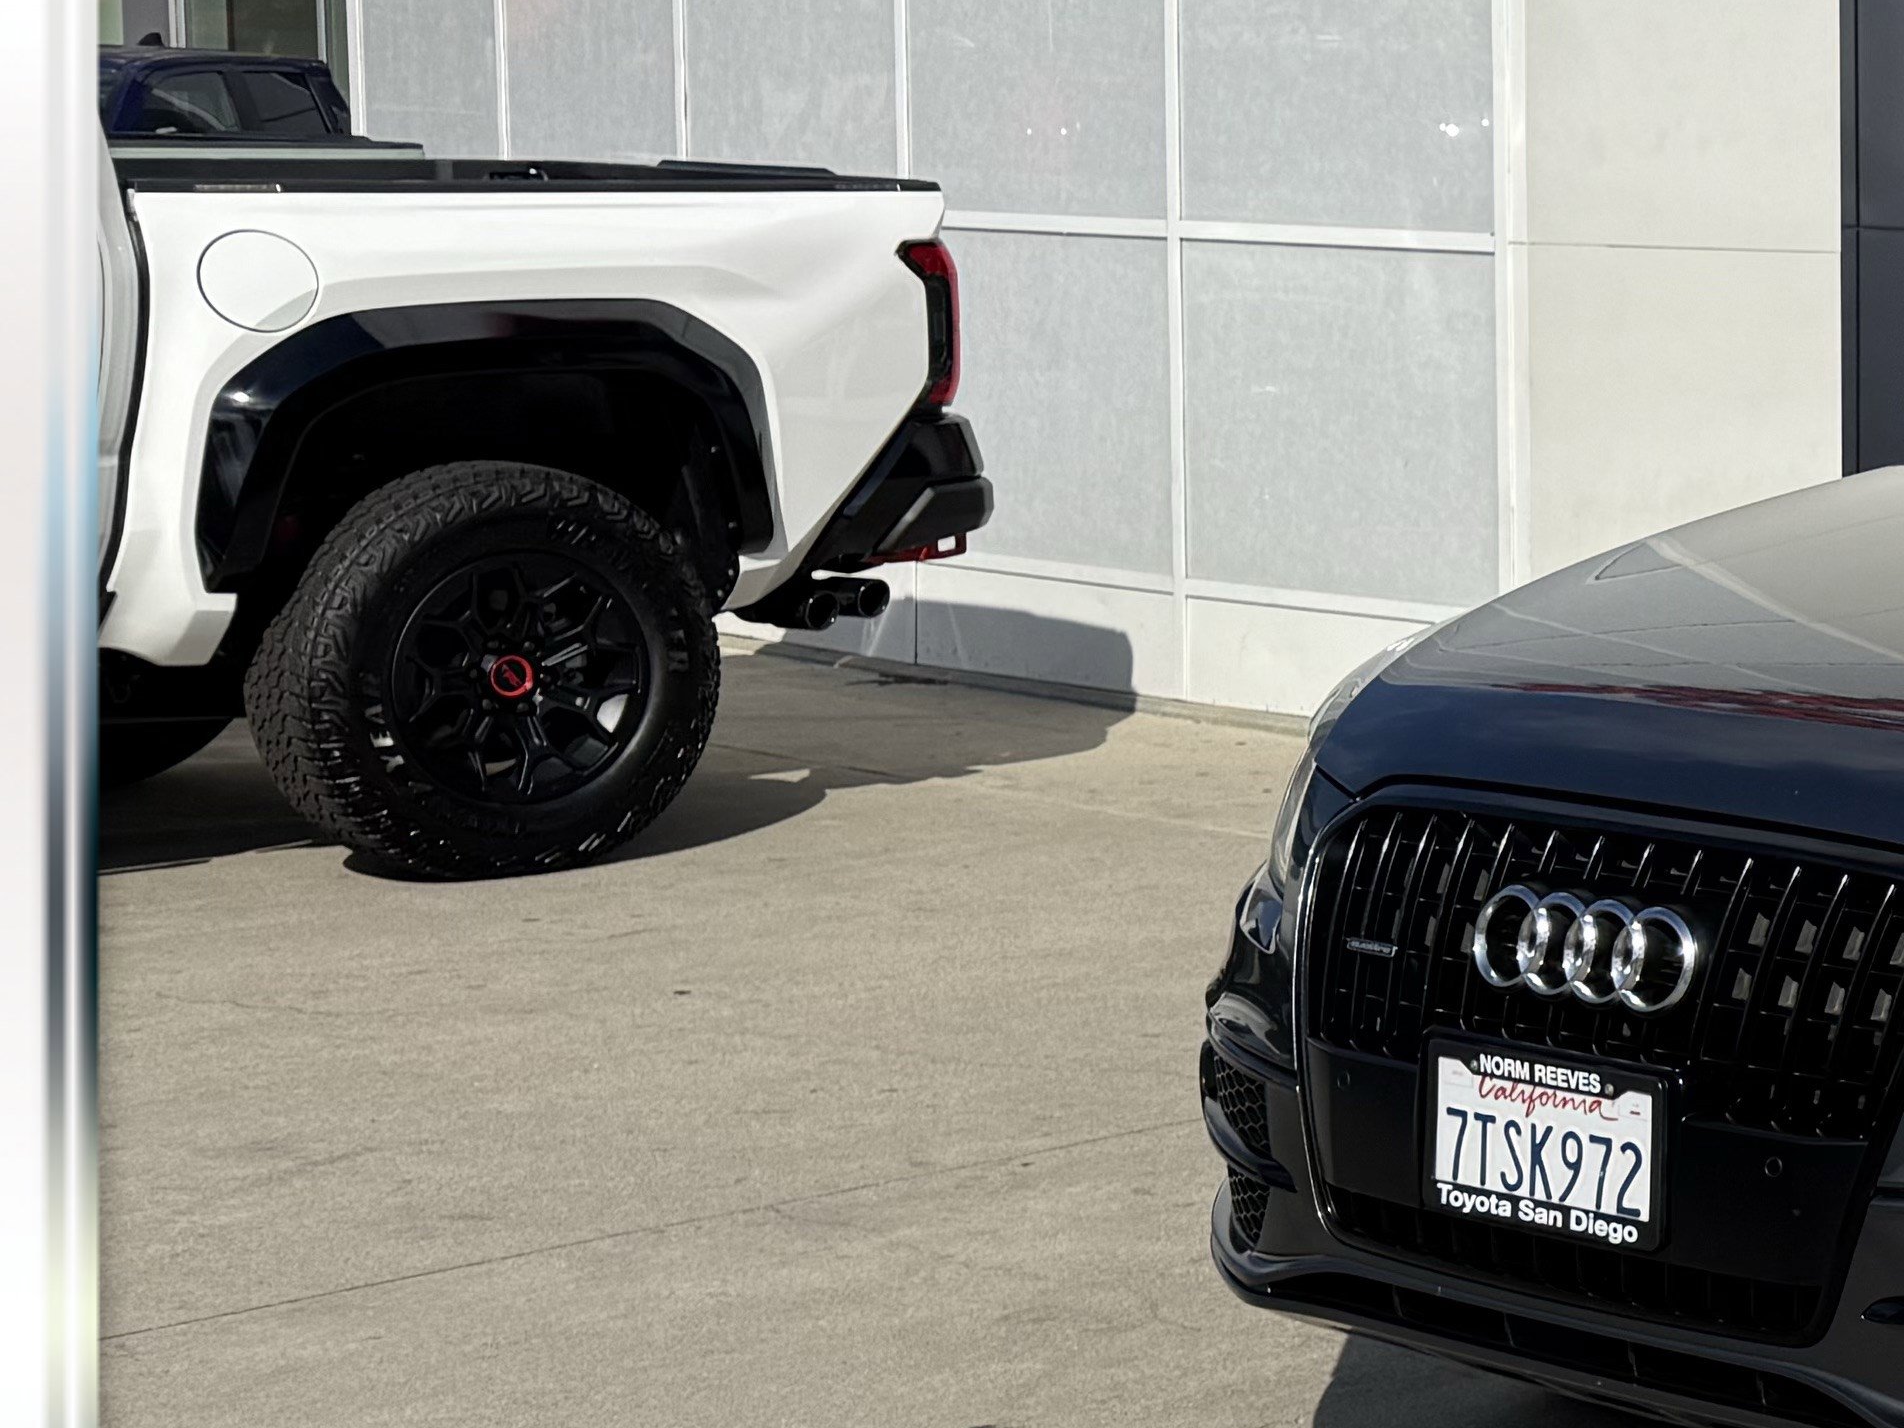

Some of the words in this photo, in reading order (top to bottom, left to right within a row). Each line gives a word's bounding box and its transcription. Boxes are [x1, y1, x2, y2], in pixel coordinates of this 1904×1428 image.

[1477, 1075, 1619, 1121] California
[1479, 1053, 1530, 1082] NORM
[1533, 1066, 1602, 1094] REEVES
[1445, 1106, 1643, 1218] 7TSK972
[1436, 1182, 1513, 1218] Toyota
[1517, 1199, 1563, 1229] San
[1569, 1209, 1639, 1245] Diego
